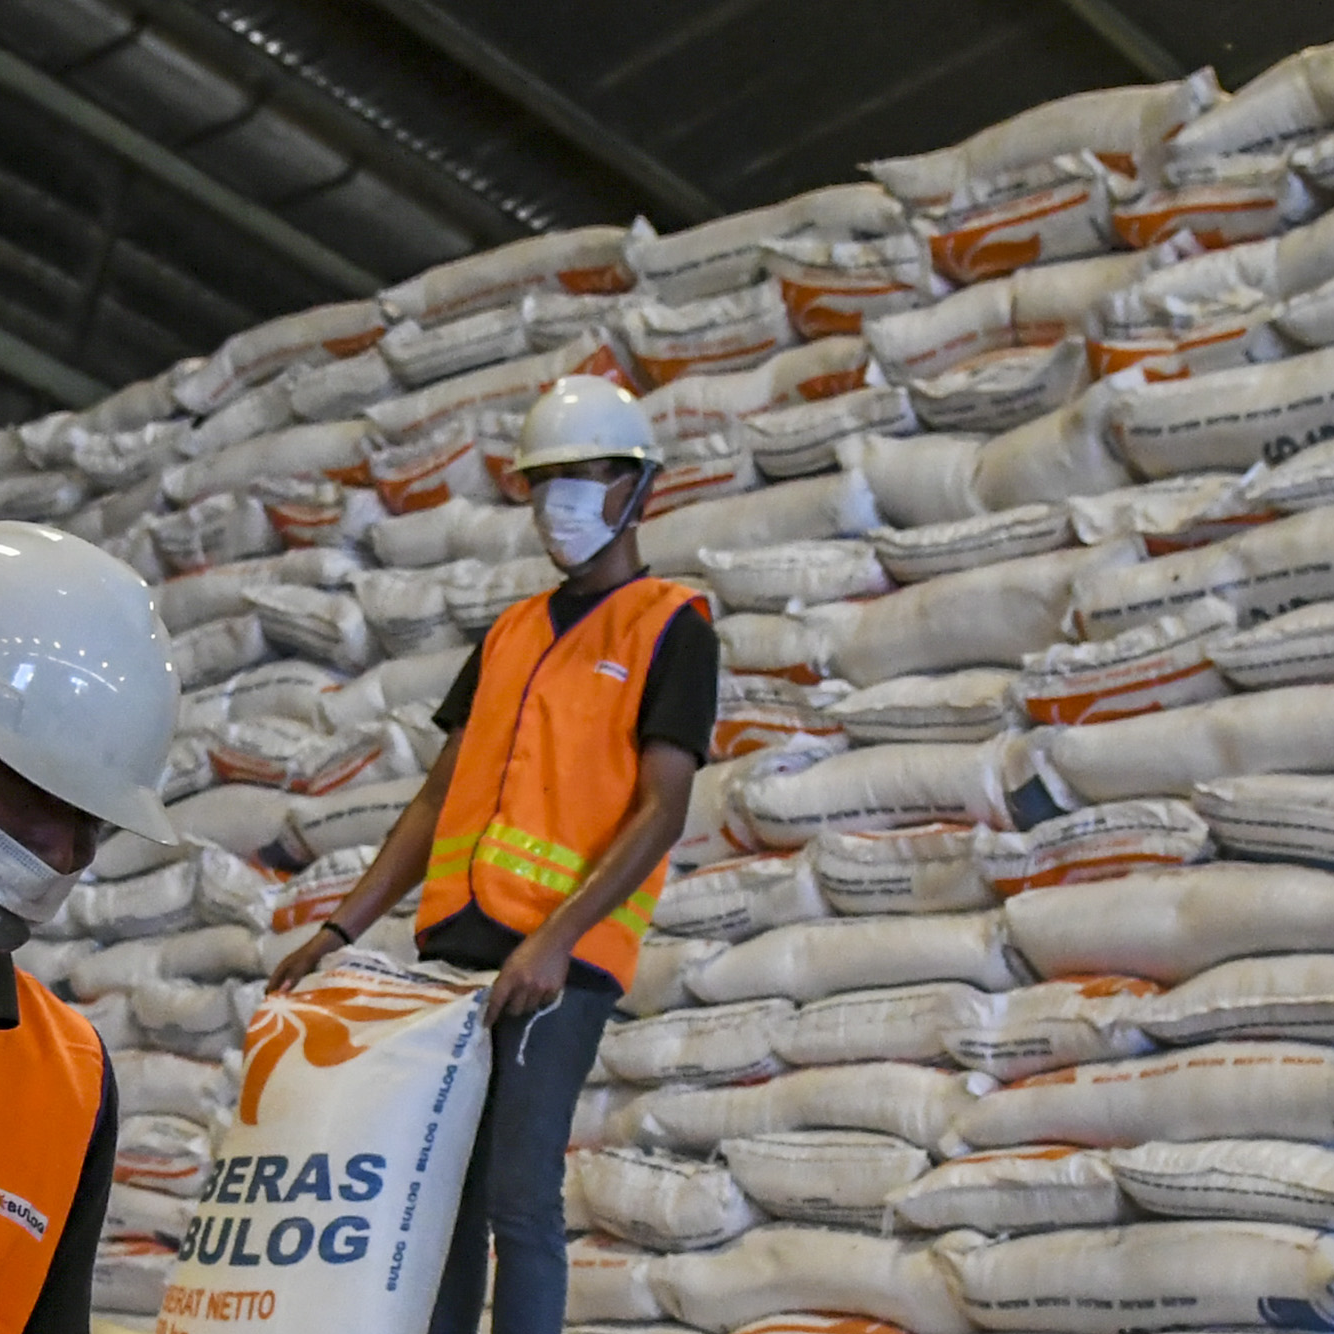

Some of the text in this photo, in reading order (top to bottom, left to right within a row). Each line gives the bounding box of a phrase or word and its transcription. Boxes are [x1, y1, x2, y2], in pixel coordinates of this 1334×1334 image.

[386, 1240, 407, 1292] BULOG
[400, 1181, 422, 1232] BULOG
[416, 1121, 439, 1173] BULOG
[433, 1063, 458, 1115] BULOG
[7, 1200, 45, 1234] BULOG
[178, 1215, 371, 1266] BULOG
[206, 1289, 276, 1321] NETTO
